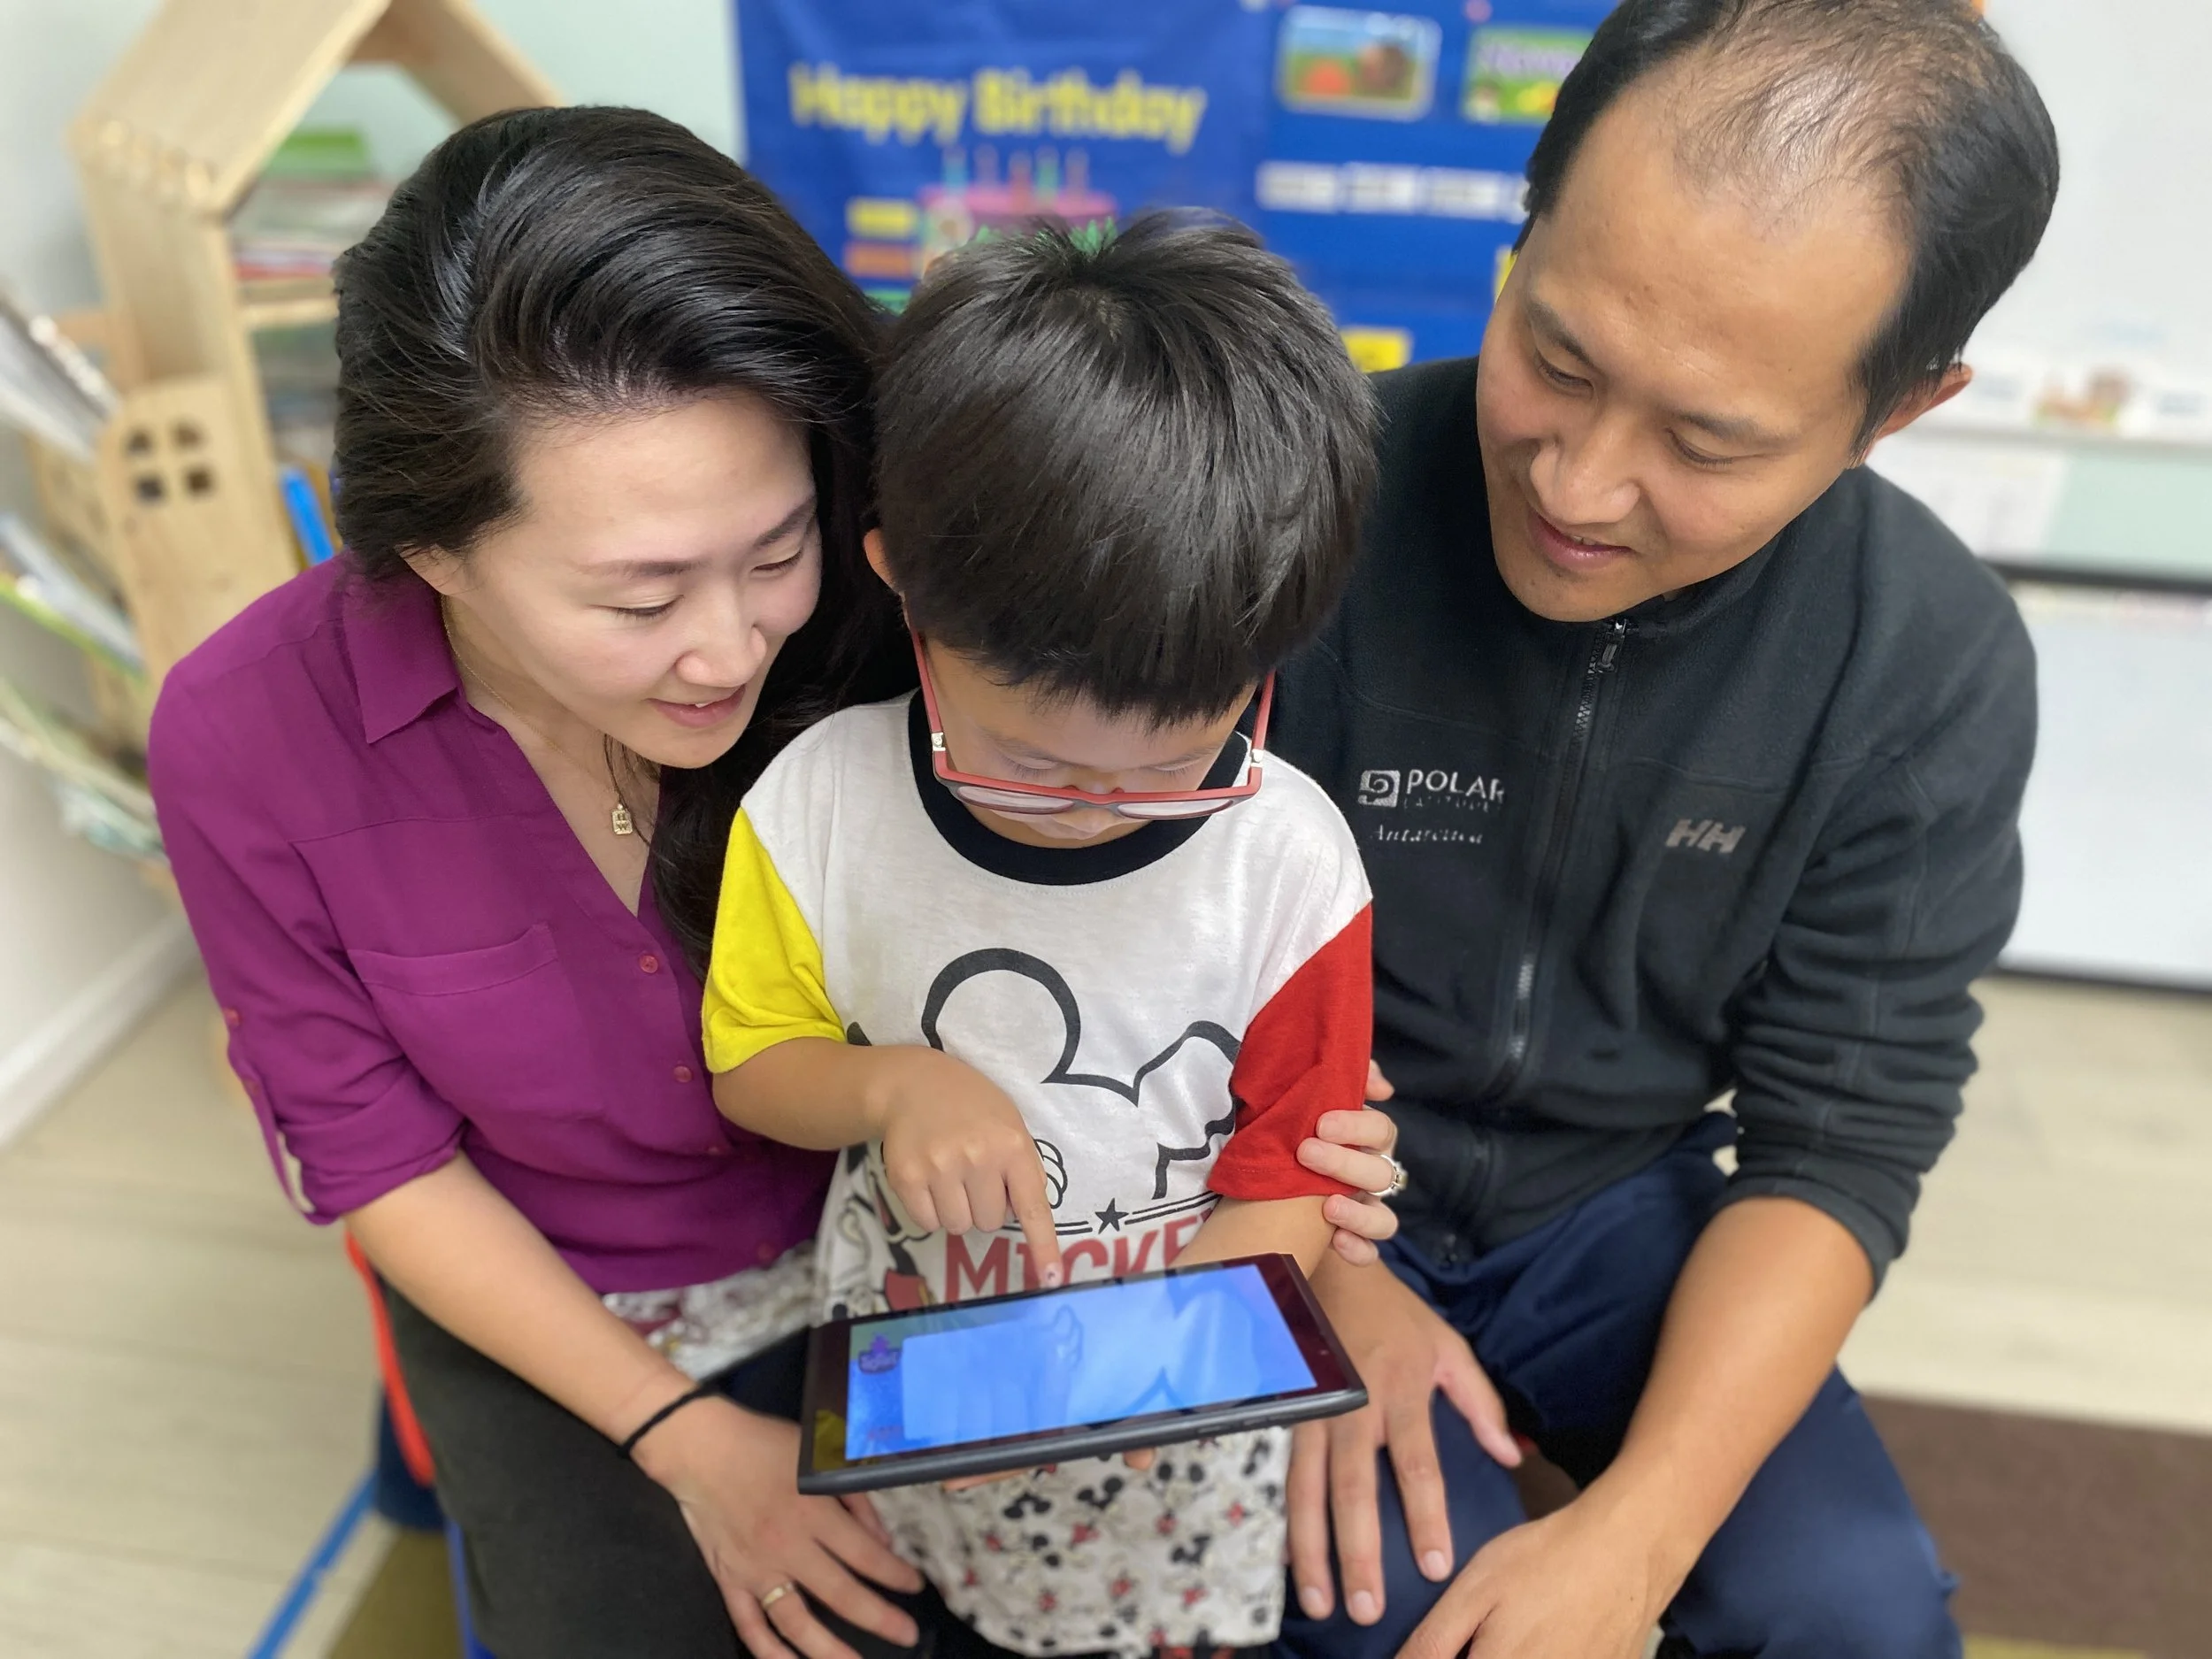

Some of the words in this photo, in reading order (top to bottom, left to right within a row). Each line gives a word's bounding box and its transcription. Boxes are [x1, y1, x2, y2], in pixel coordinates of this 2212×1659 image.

[789, 64, 968, 146] Happy
[975, 66, 1206, 154] Birthday
[1665, 818, 1746, 853] HH
[945, 1208, 1213, 1304] MICKE
